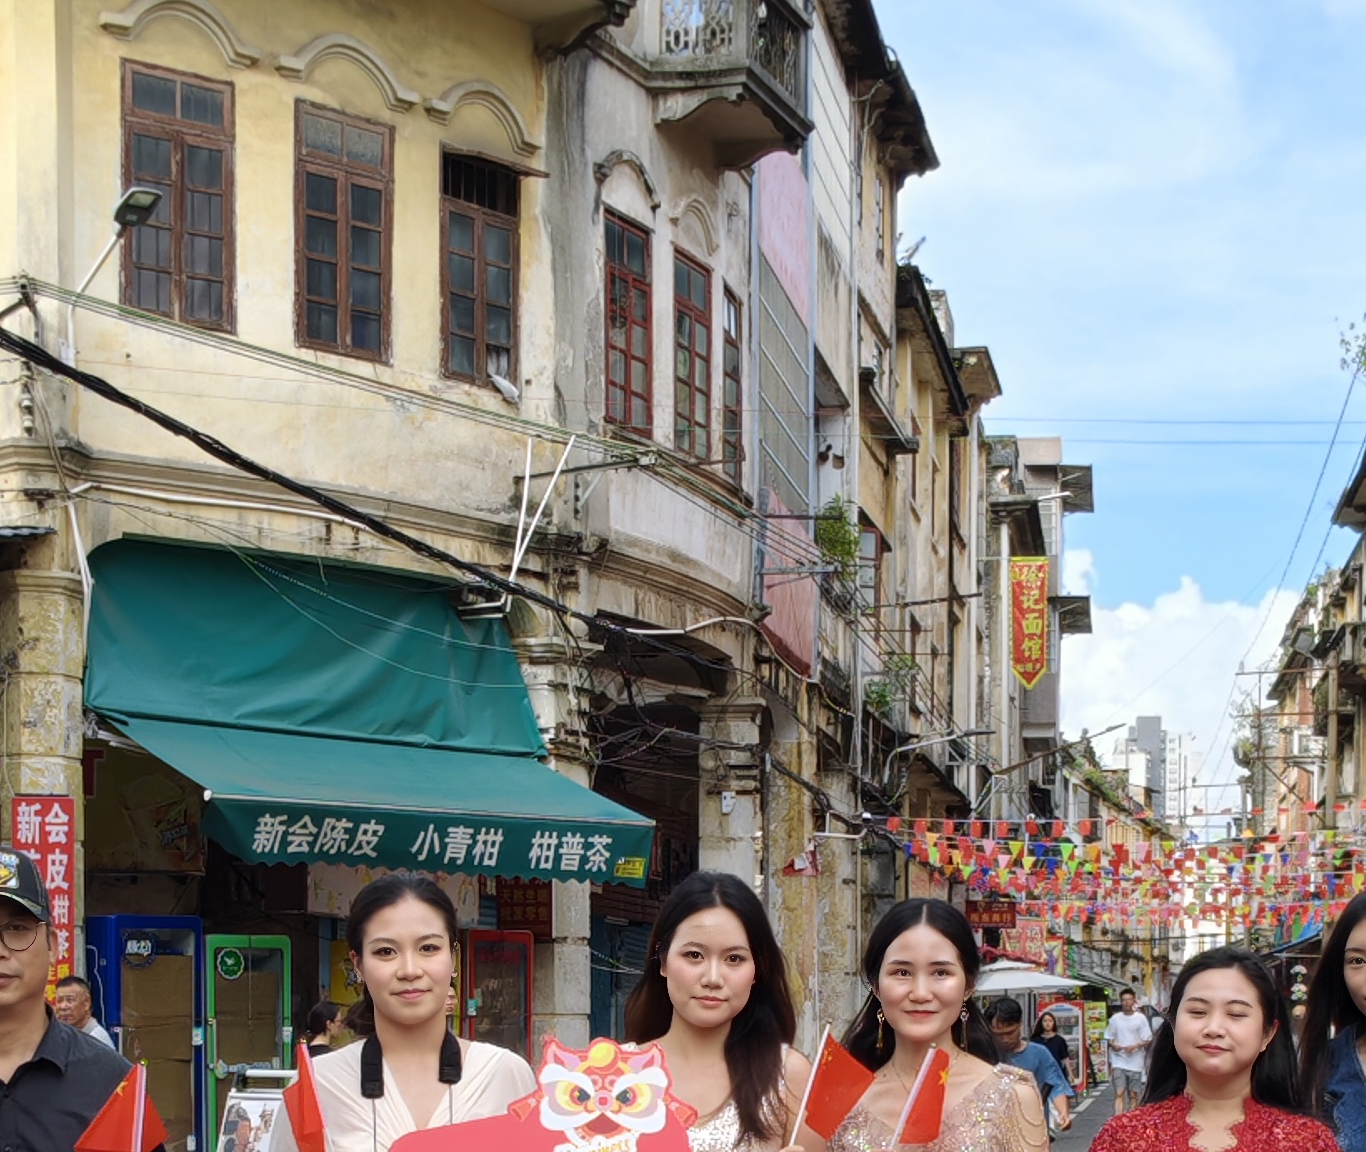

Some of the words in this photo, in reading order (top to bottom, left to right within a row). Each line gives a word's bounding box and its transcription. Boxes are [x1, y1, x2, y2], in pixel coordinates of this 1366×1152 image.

[1020, 566, 1044, 661] 徐记面馆
[16, 801, 71, 846] 新会
[251, 813, 387, 858] 新会陈皮
[409, 824, 505, 868] 小青柑
[528, 831, 614, 873] 柑普茶
